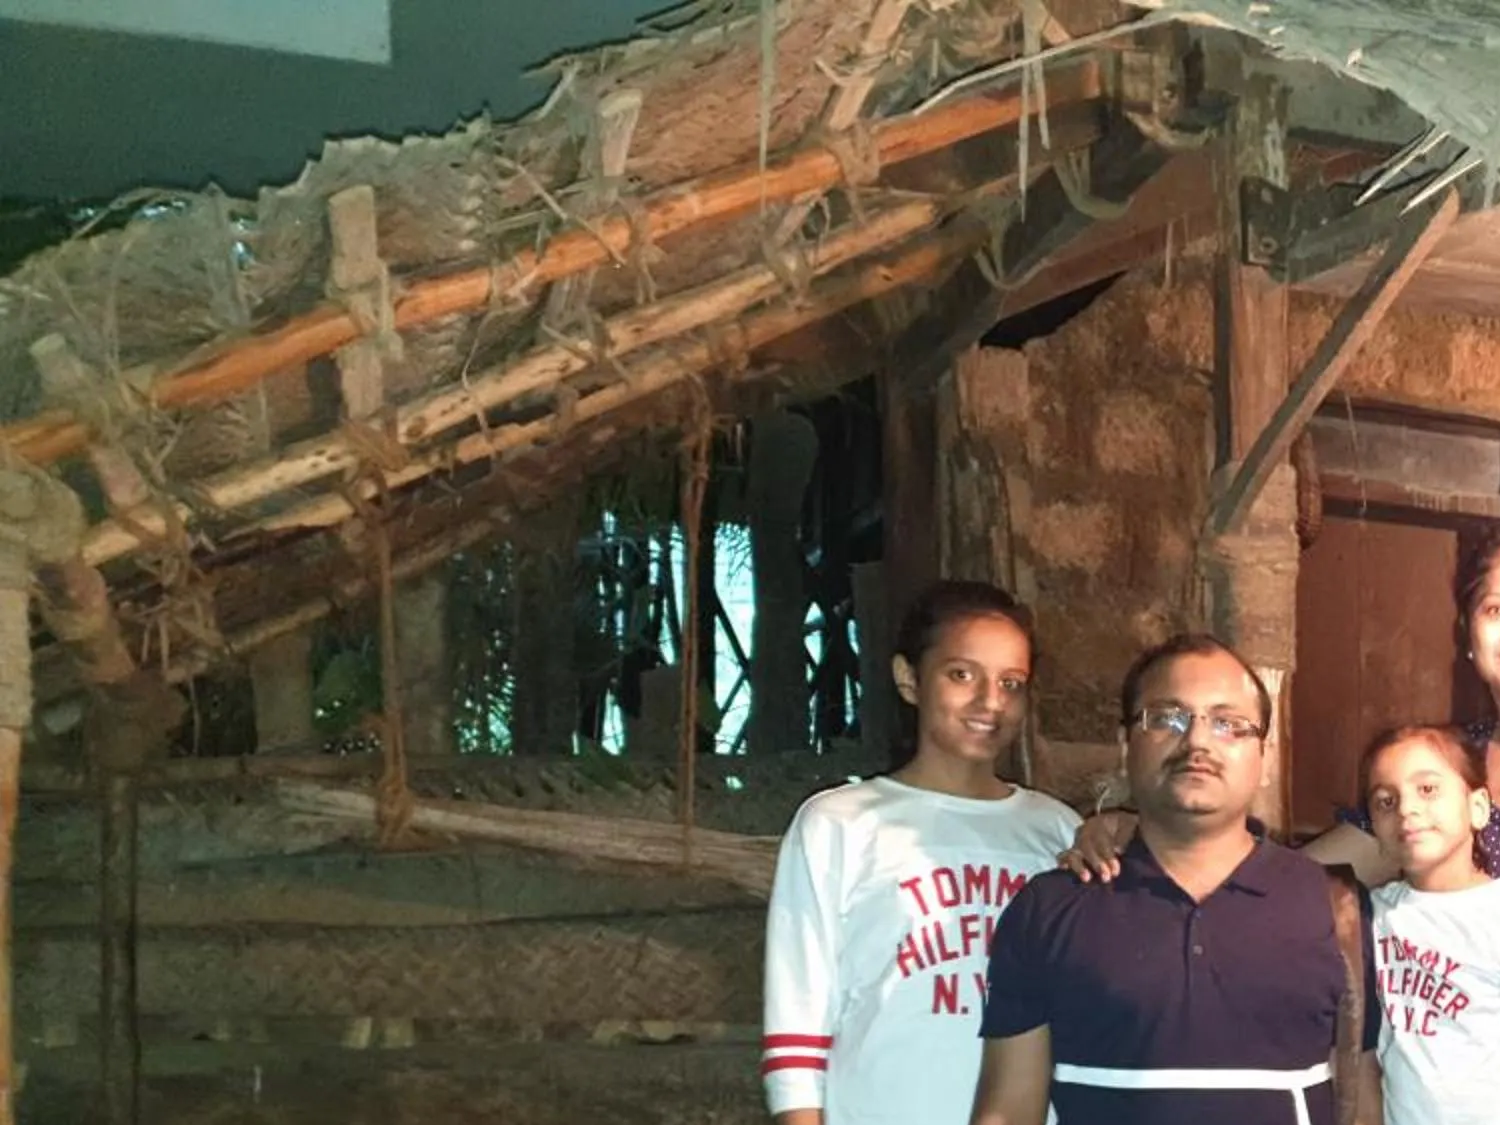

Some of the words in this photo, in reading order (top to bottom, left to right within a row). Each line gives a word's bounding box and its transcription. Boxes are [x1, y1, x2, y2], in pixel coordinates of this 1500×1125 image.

[899, 863, 1027, 916] TOMM
[896, 914, 996, 978] HILFI
[1376, 967, 1470, 1020] ILFIGER
